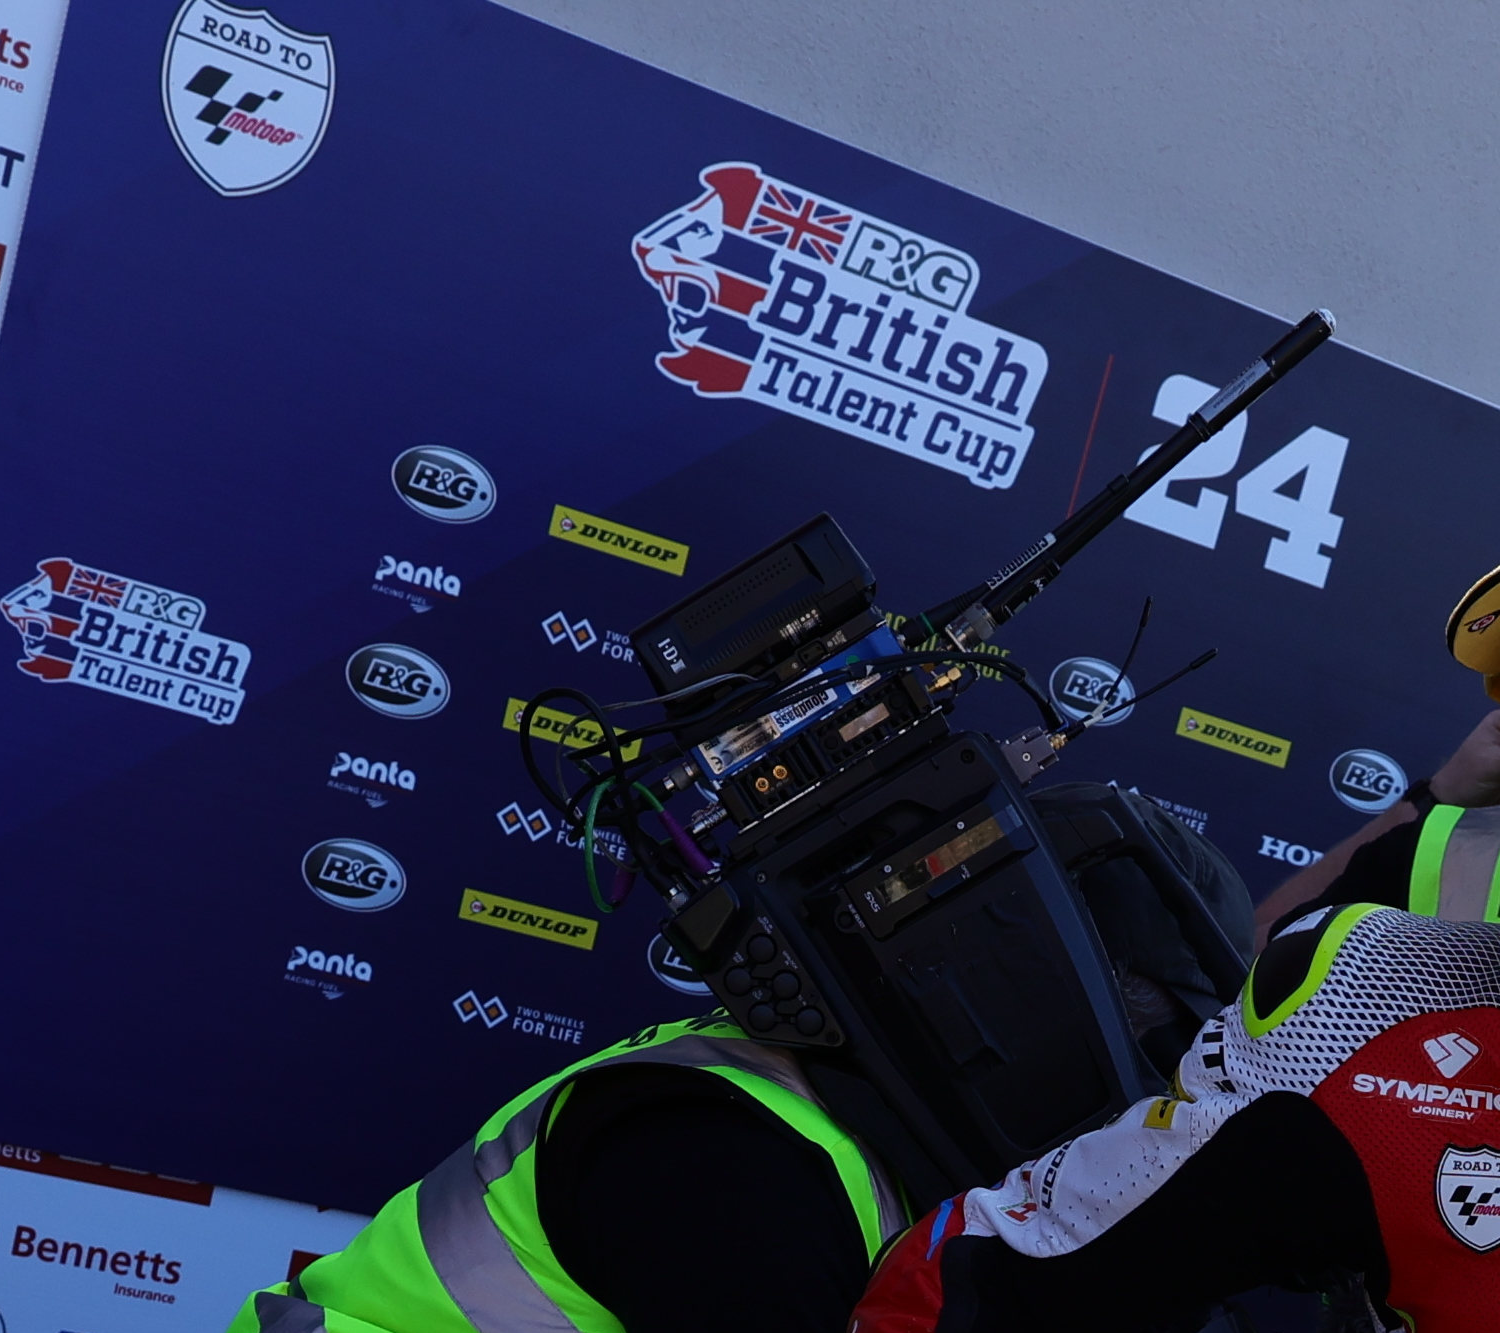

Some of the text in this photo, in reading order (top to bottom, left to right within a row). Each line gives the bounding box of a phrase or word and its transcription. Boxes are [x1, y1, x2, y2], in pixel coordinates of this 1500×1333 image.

[202, 15, 313, 71] ROAD TO
[843, 226, 969, 308] R&G
[758, 258, 1030, 414] British
[759, 347, 1018, 481] Talent Cup
[410, 461, 476, 501] R&G
[1124, 374, 1350, 589] 24
[579, 522, 679, 565] DUNLOP
[375, 555, 462, 598] panta
[125, 586, 200, 630] R&G
[76, 606, 240, 683] British
[601, 643, 634, 663] FOR
[77, 658, 236, 721] Talent Cup
[364, 659, 431, 698] R&G
[1064, 670, 1120, 709] R&G
[533, 716, 631, 748] DUNL
[1201, 723, 1282, 756] DUNLOP
[330, 752, 417, 791] panta
[1343, 767, 1392, 796] R&G
[322, 858, 386, 893] R&G
[488, 905, 588, 940] DUNLOP
[287, 946, 373, 982] panta
[513, 1017, 583, 1046] FOR LIFE
[516, 1006, 585, 1030] TWO WHEELS
[1412, 1105, 1476, 1122] JOINERY
[1453, 1160, 1492, 1174] ROAD
[11, 1226, 182, 1285] Bennetts
[113, 1283, 175, 1305] Insurance
